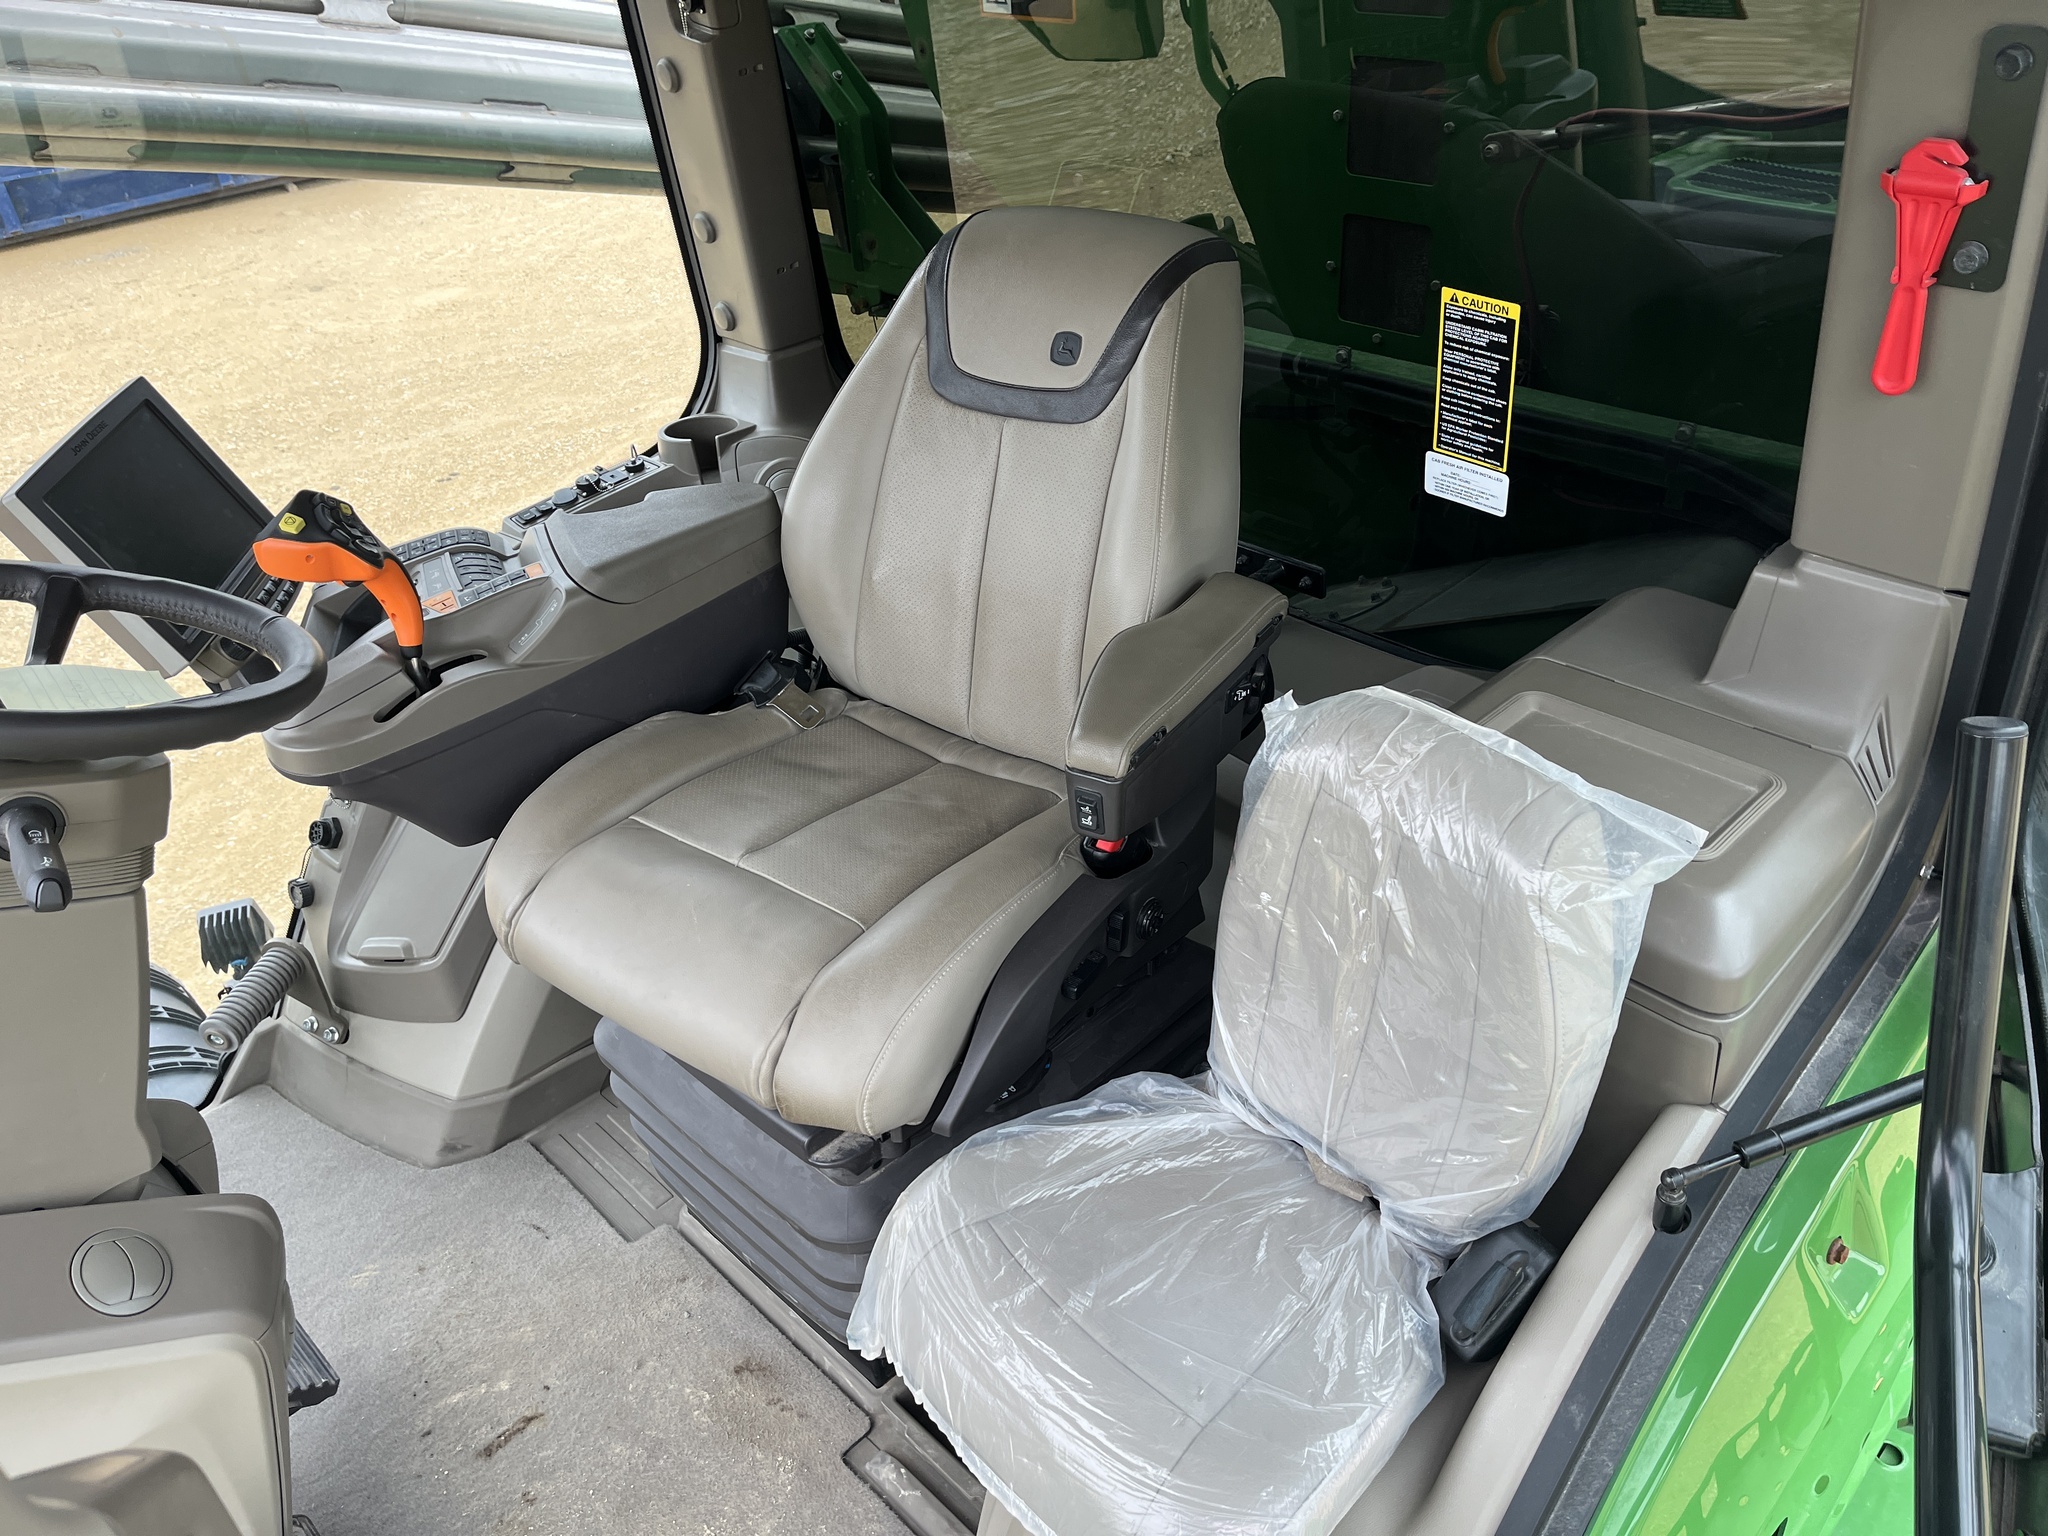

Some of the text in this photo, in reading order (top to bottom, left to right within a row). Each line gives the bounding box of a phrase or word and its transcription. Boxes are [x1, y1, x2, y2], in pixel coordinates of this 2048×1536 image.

[1462, 296, 1509, 316] CAUTION
[71, 420, 108, 456] JOHN DEERE
[1441, 460, 1455, 468] FRESH
[1464, 467, 1478, 476] FILTER
[1479, 472, 1503, 483] INSTALLED
